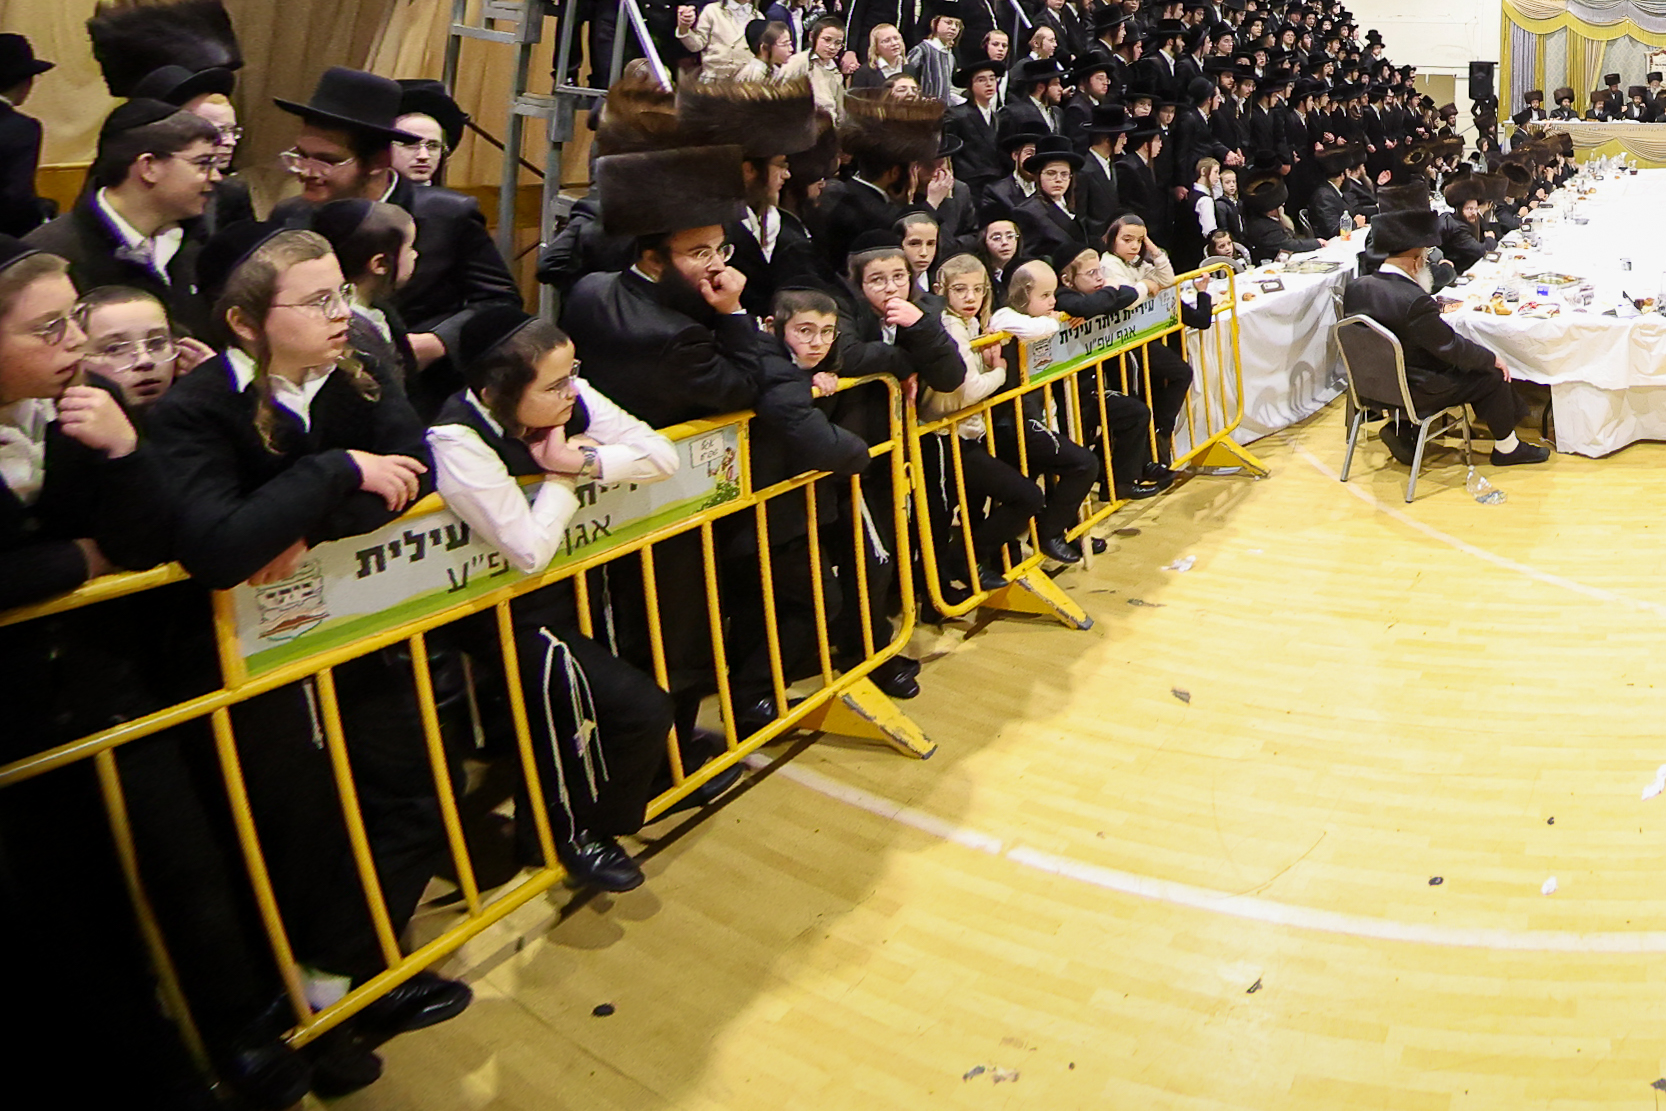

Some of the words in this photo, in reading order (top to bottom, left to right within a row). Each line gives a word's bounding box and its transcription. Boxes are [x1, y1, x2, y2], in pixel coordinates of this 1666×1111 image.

[1059, 320, 1092, 345] עילית
[1095, 311, 1121, 330] ביתר
[1116, 324, 1137, 344] אגף
[355, 520, 471, 580] עילית
[447, 551, 510, 594] פ"ע
